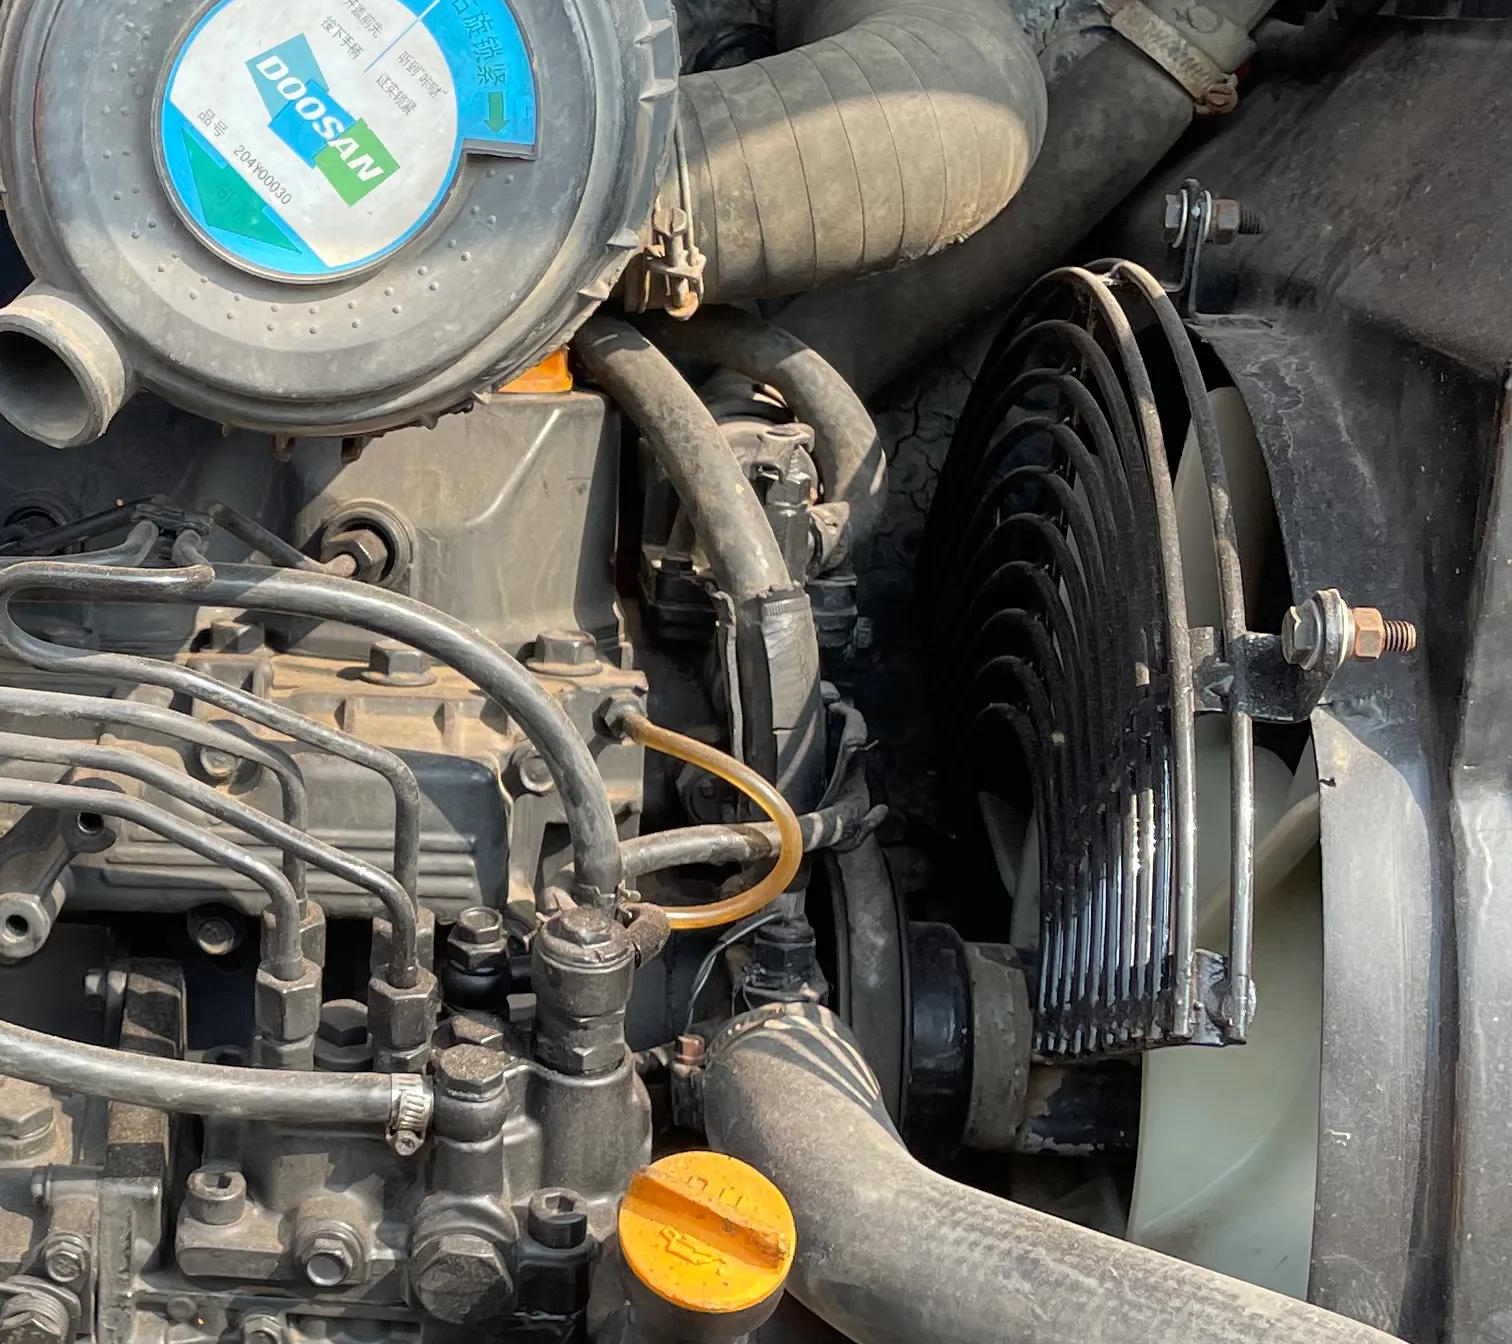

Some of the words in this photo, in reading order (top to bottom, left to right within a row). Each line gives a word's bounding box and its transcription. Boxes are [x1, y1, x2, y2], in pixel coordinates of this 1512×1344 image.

[197, 108, 229, 137] 品号
[233, 144, 292, 205] 204Y00030
[255, 55, 384, 182] DOOSAN
